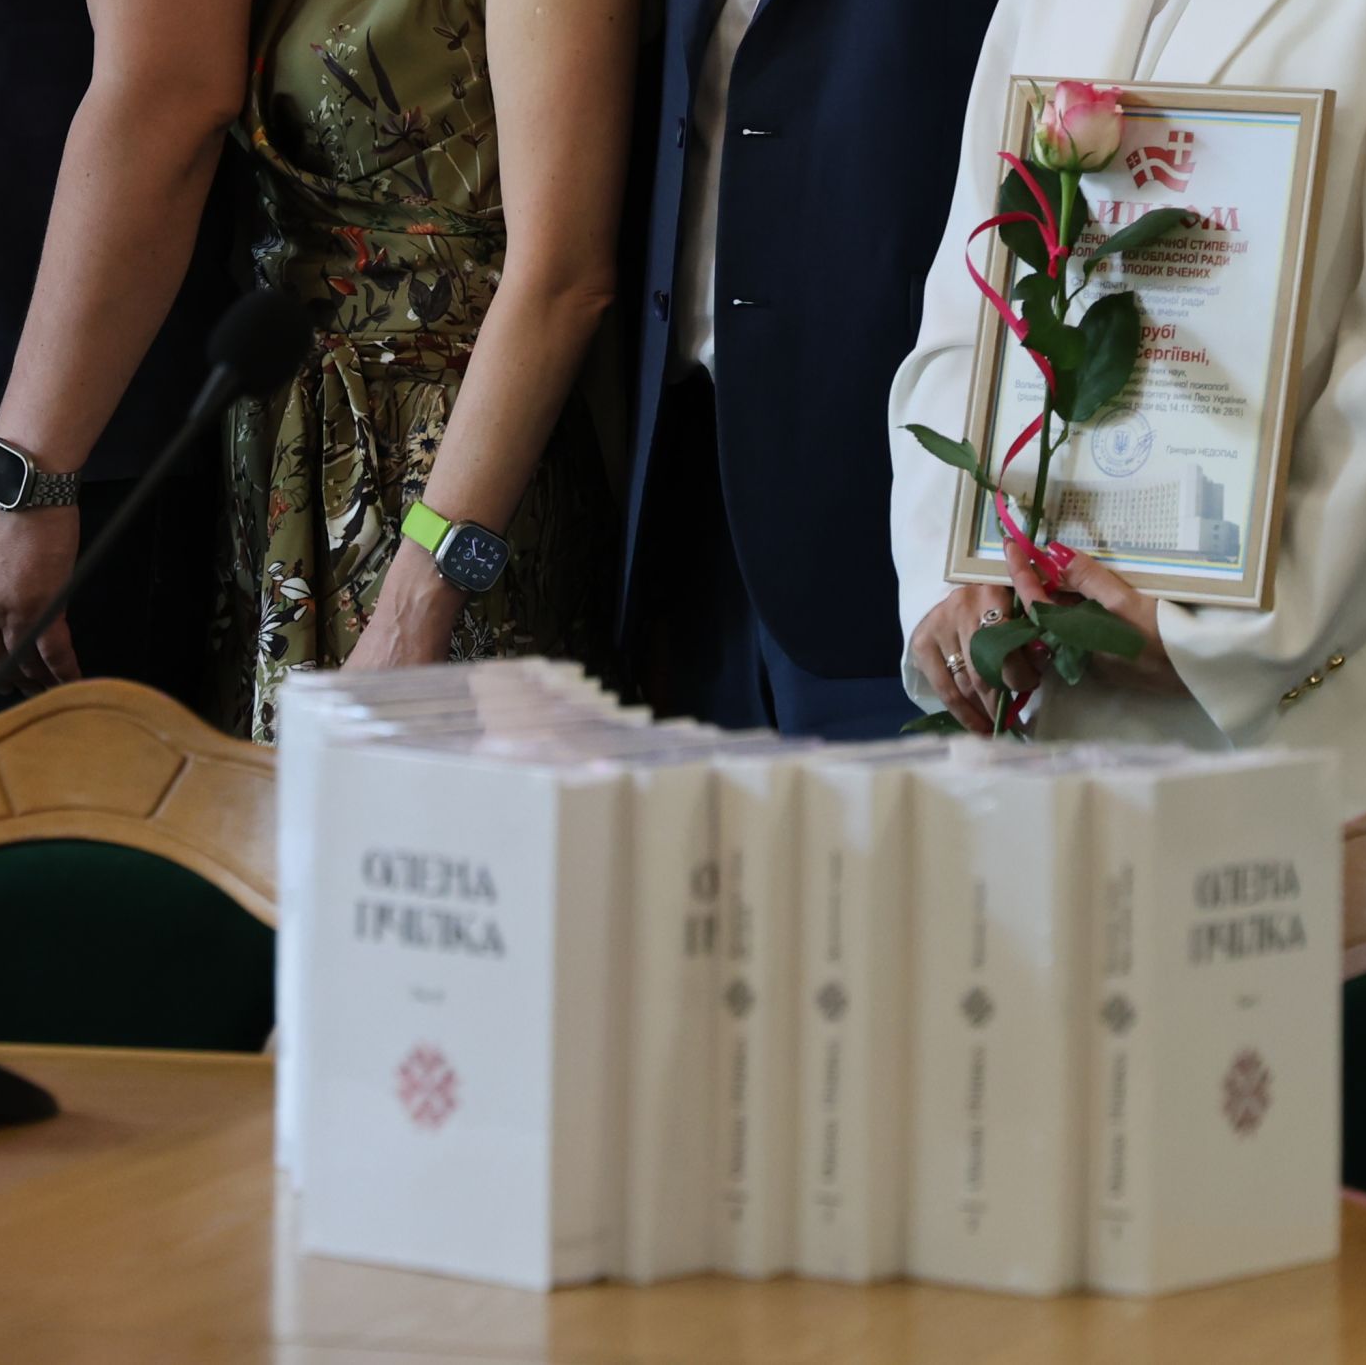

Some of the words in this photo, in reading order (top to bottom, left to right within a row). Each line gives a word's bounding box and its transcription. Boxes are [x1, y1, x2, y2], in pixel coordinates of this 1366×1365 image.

[1190, 239, 1250, 255] СТИПЕНДІЇ
[1141, 250, 1198, 265] ОБЛАСНОЇ
[1201, 254, 1231, 267] РАДИ
[1166, 268, 1211, 281] ВЧЕНИХ
